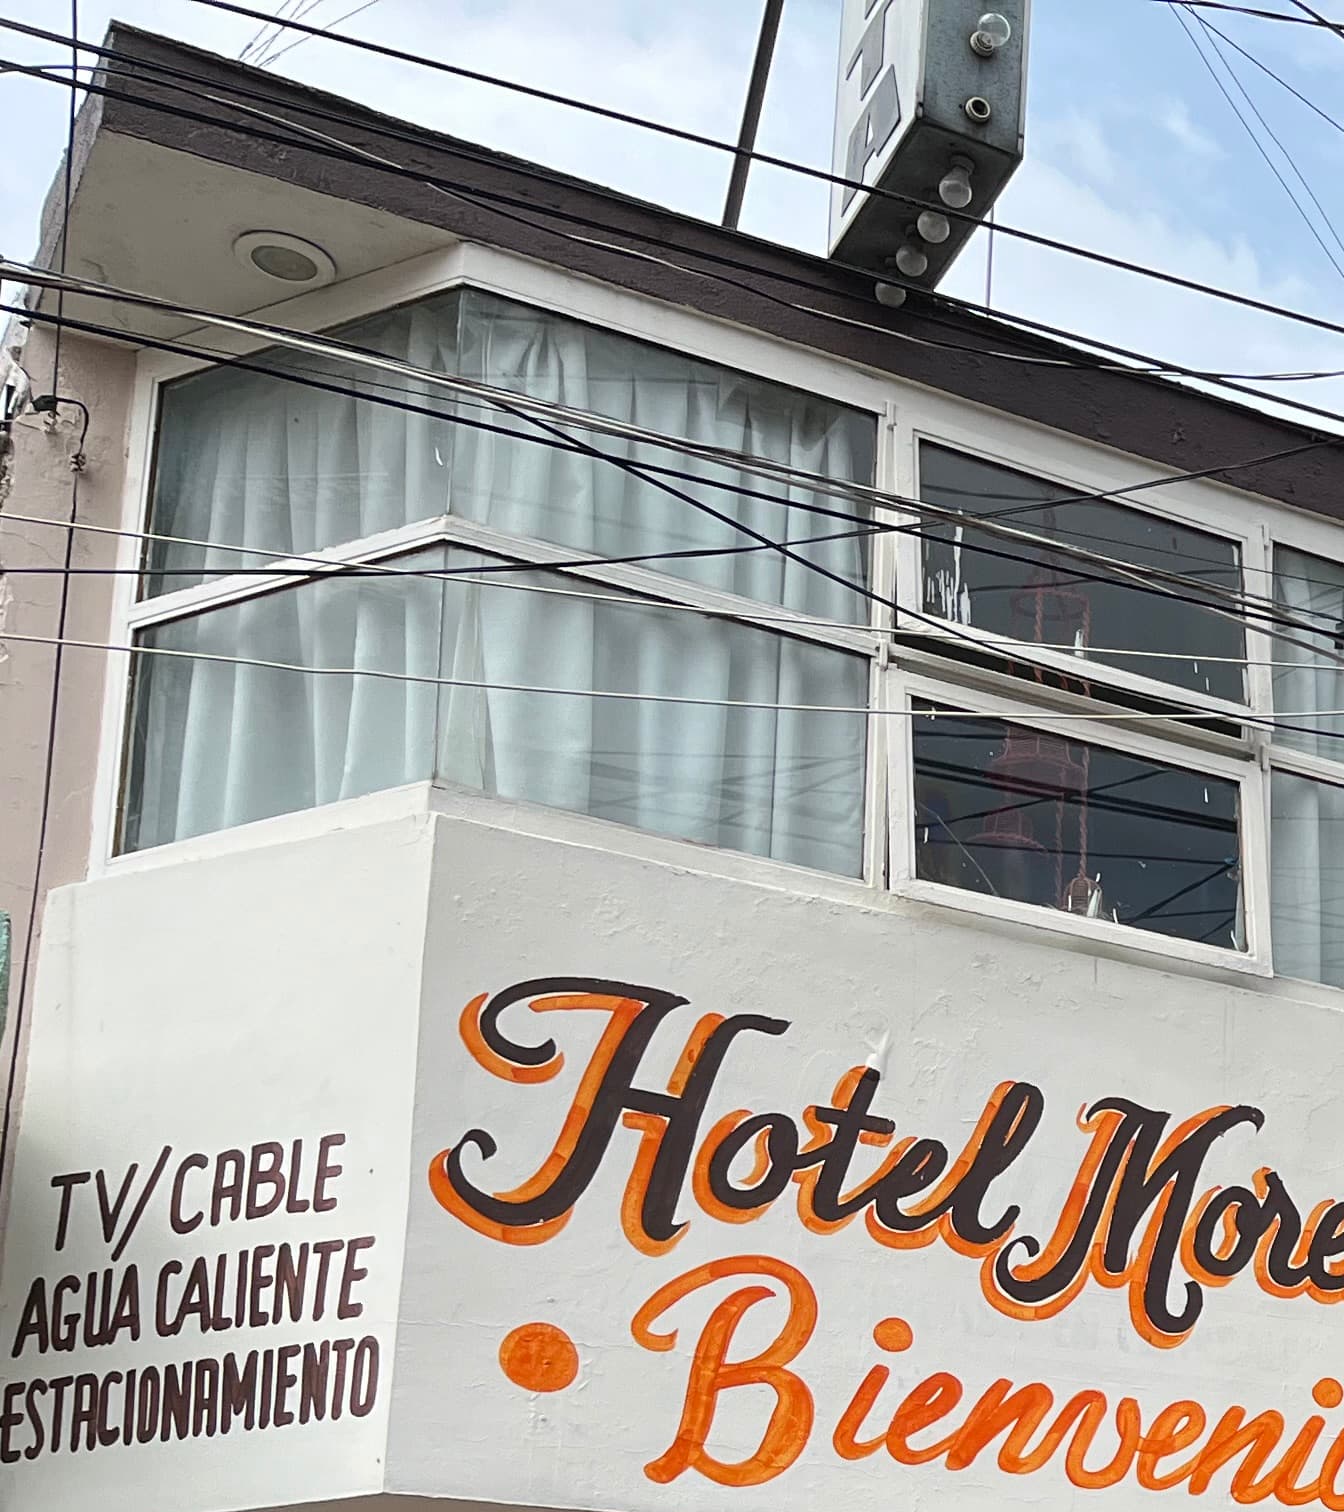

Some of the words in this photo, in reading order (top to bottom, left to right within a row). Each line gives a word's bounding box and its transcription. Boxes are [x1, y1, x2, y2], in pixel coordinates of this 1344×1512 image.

[429, 977, 1043, 1257] Hotel
[50, 1133, 346, 1262] TV/CABLE
[12, 1263, 141, 1358] AGUA
[155, 1235, 376, 1338] CALIENTE
[0, 1335, 380, 1463] ESTACIONAMIENTO
